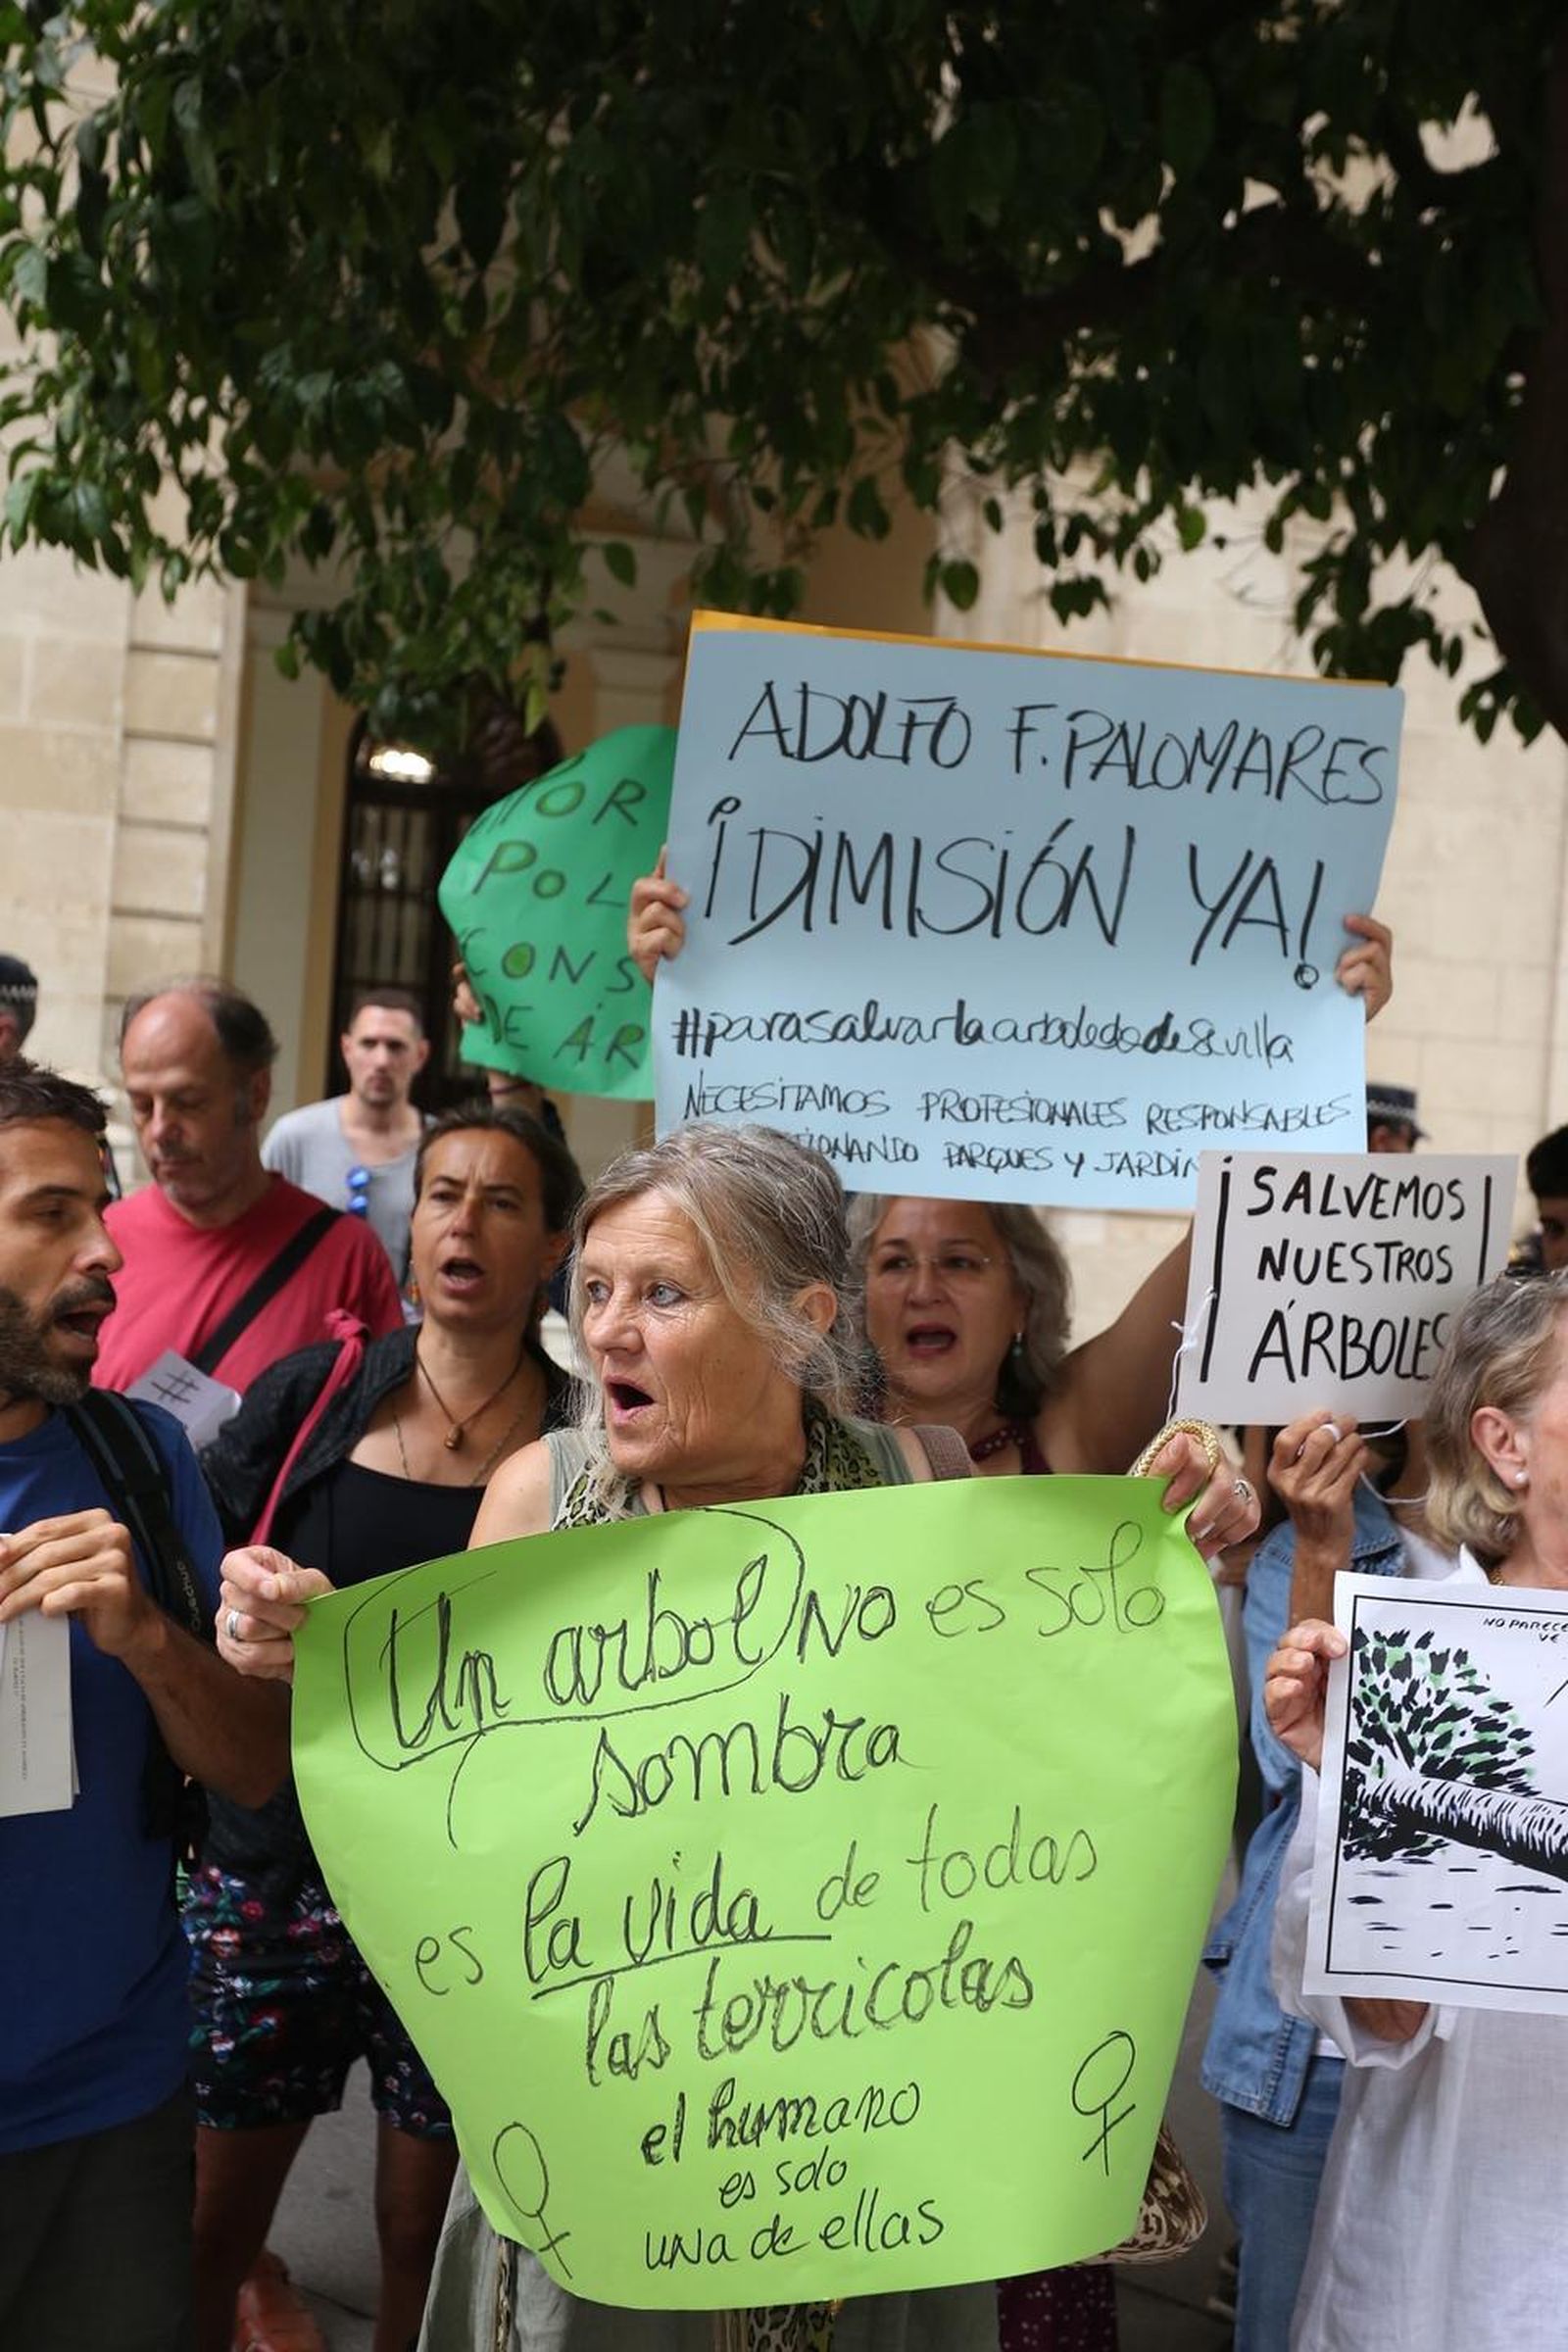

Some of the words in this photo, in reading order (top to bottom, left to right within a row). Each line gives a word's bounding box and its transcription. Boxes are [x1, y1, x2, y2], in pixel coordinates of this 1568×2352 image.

[728, 680, 971, 768] ADOLFO
[1189, 843, 1325, 990] YA!
[683, 1068, 891, 1120] NECESITAMOS
[1145, 1093, 1352, 1136] RESPONSABLES
[942, 1141, 1054, 1174] PARQUES
[1247, 1165, 1466, 1222] SALVEMOS
[1256, 1237, 1454, 1286] NUESTROS
[543, 1554, 768, 1707] arbol
[925, 1577, 1005, 1638] es
[1483, 1617, 1505, 1628] NO
[573, 1692, 916, 1837] sombra
[415, 1925, 485, 1996] es
[523, 1856, 590, 1984] la
[624, 1849, 773, 1965] vida
[816, 1839, 881, 1922] de
[906, 1802, 1099, 1913] todas
[586, 1978, 671, 2087] las
[642, 2092, 685, 2167] el
[708, 2078, 922, 2149] humano
[718, 2167, 757, 2208] es
[777, 2144, 850, 2199] solo
[750, 2213, 809, 2259] de
[819, 2187, 945, 2253] ellas
